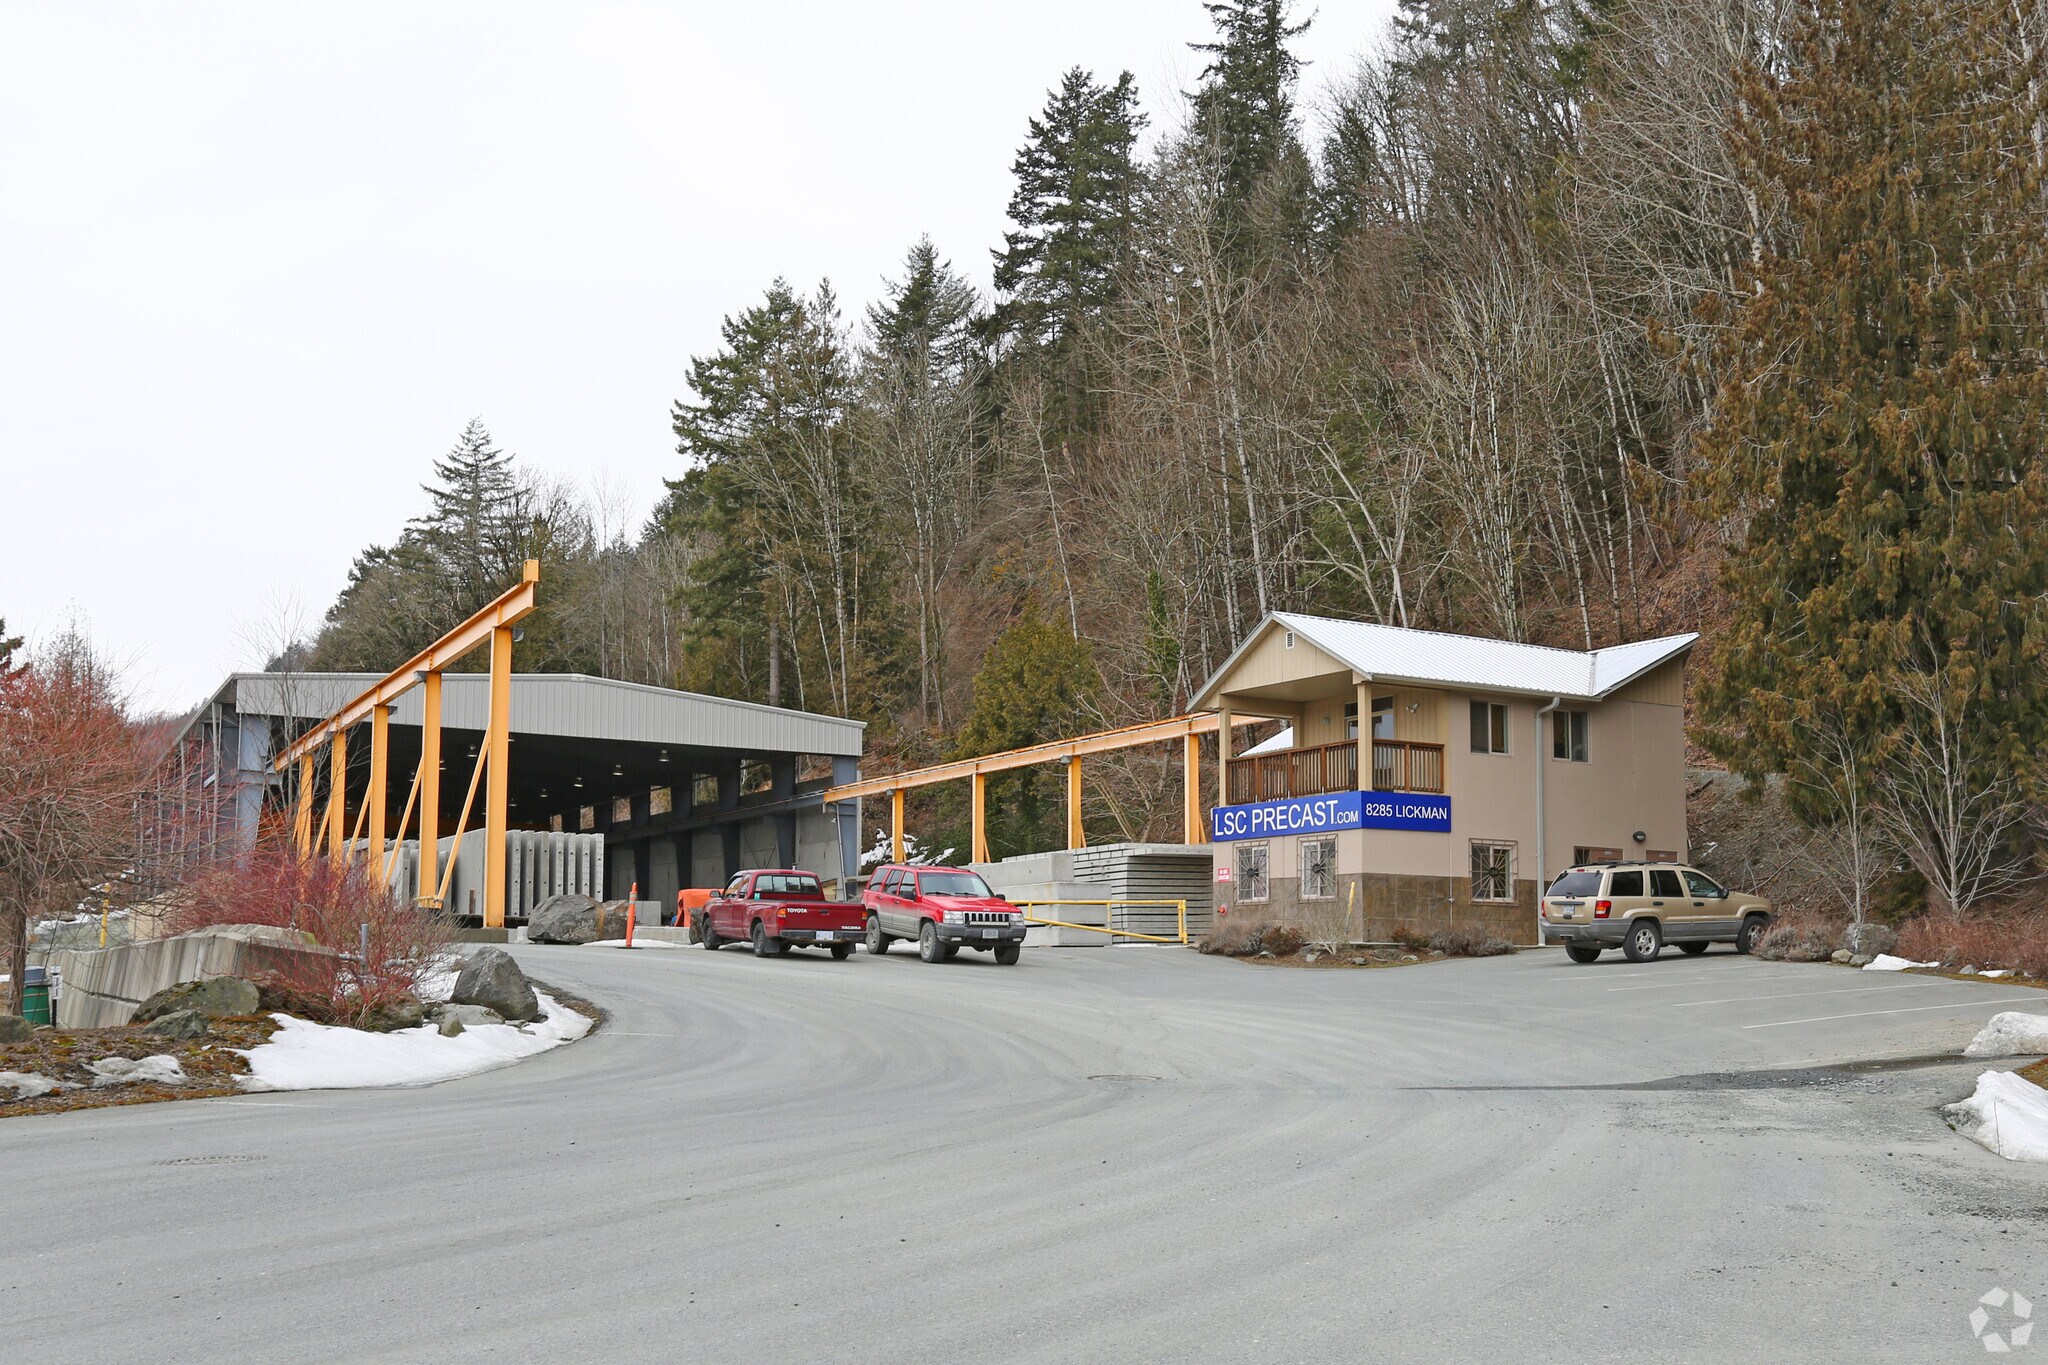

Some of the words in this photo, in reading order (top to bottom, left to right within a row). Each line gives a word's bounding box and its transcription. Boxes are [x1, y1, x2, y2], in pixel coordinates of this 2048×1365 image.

[1215, 810, 1247, 836] LSC
[1252, 800, 1358, 832] PRECAST.COM
[1366, 803, 1392, 816] 8285
[1395, 805, 1447, 820] LICKMAN
